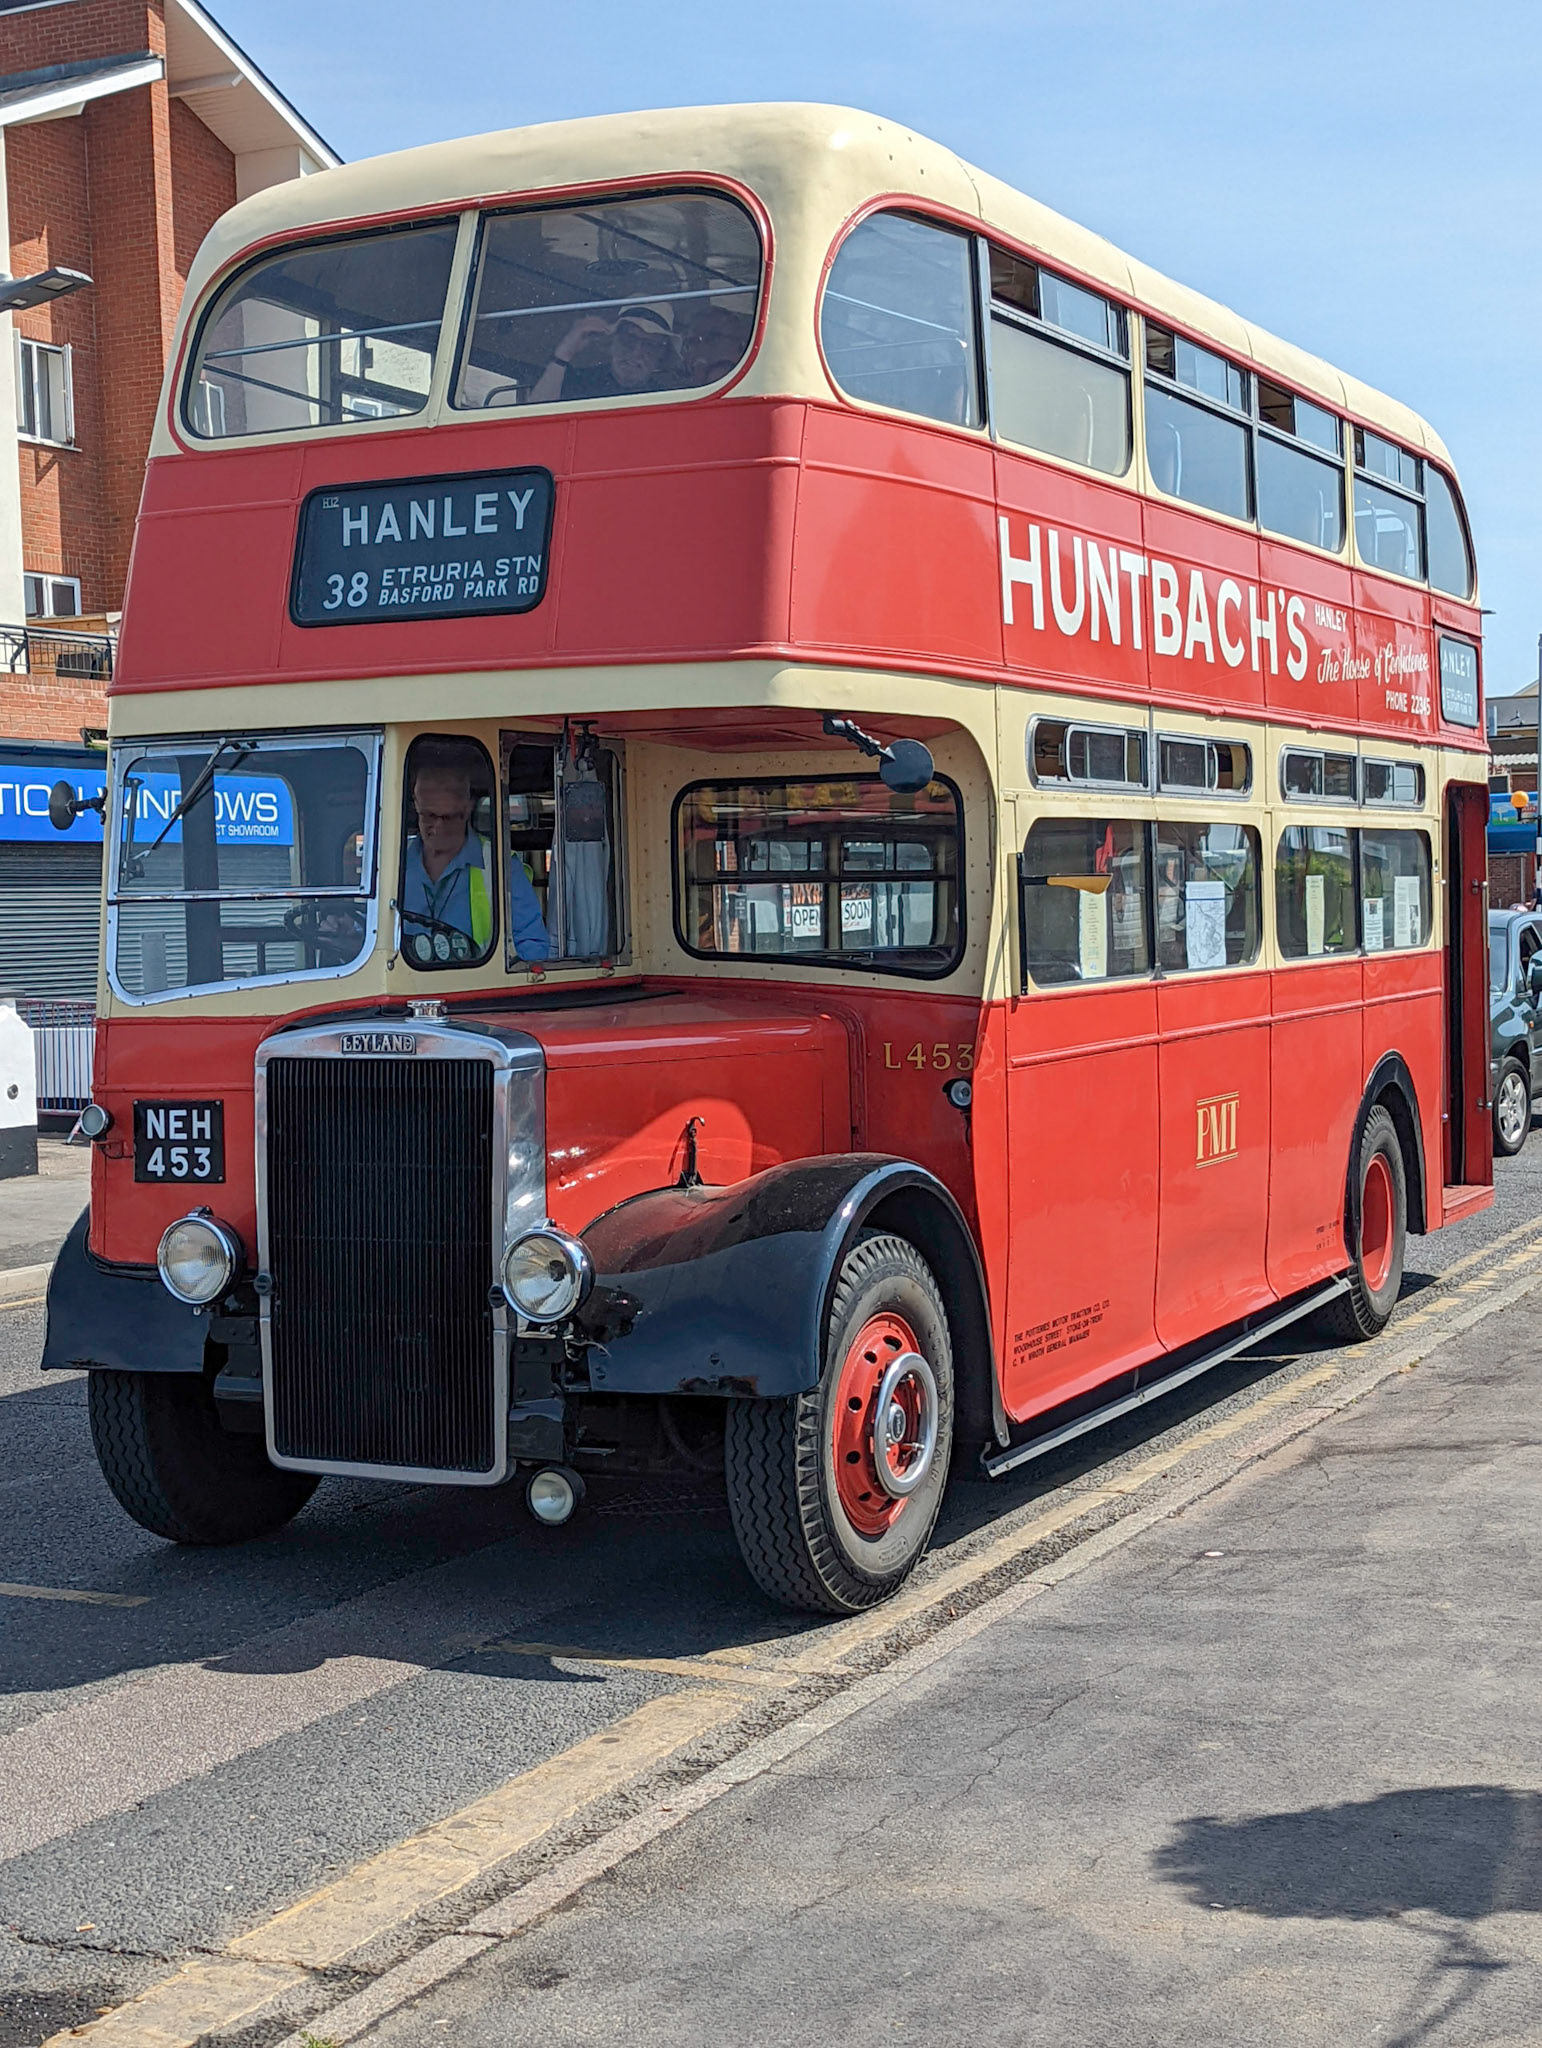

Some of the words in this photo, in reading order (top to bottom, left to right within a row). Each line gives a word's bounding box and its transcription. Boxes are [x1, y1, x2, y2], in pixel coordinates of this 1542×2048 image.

[343, 488, 535, 547] HANLEY
[382, 560, 486, 586] ETRURIA
[495, 554, 542, 576] STN
[323, 571, 369, 610] 38
[378, 583, 454, 606] BASFORD
[463, 579, 508, 599] PARK
[517, 575, 539, 595] RD
[999, 516, 1308, 681] HUNTBACH'S
[1315, 603, 1347, 633] HANLEY
[1317, 648, 1340, 684] The
[1342, 647, 1371, 682] House
[1374, 646, 1383, 686] of
[1383, 642, 1429, 685] Confidence
[1442, 648, 1471, 678] ANLEY
[1386, 689, 1408, 713] PHONE
[228, 824, 279, 837] SHOWROOM
[844, 901, 870, 920] SOON
[343, 1034, 413, 1052] LEYLAND
[883, 1042, 974, 1071] L453
[146, 1109, 211, 1140] NEH
[1196, 1100, 1240, 1160] PMT
[147, 1146, 211, 1177] 453
